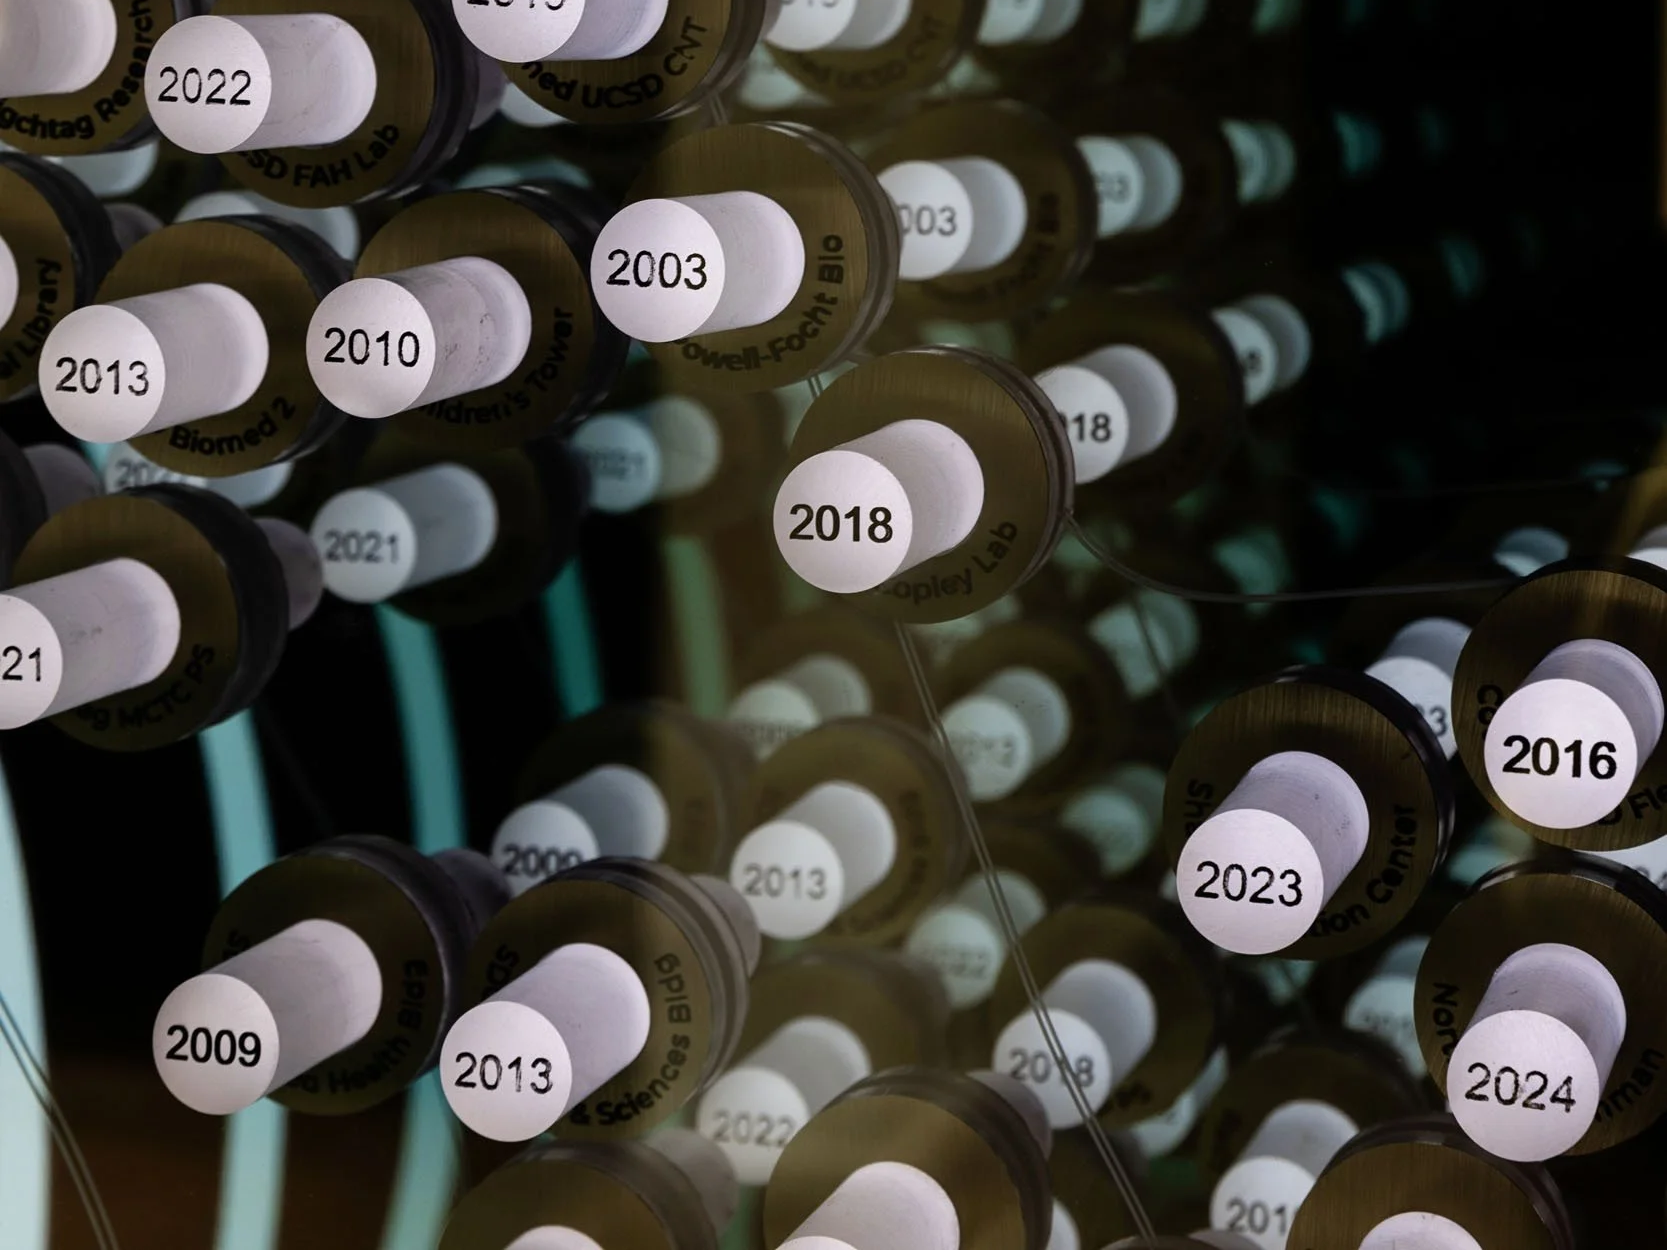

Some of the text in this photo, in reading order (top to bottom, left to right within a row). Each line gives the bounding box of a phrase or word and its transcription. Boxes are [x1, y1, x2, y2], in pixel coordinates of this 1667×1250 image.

[158, 66, 251, 105] 2022
[521, 61, 578, 101] ned
[582, 74, 664, 108] UCSD
[238, 123, 400, 189] SD FAH Lab
[606, 248, 708, 290] 2003
[15, 257, 62, 358] Library
[675, 285, 838, 372] owell-Focht
[818, 234, 845, 285] Bio
[324, 327, 420, 368] 2010
[524, 307, 574, 391] Tower
[55, 357, 149, 396] 2013
[169, 396, 296, 456] Biomed 2
[789, 504, 893, 543] 2018
[324, 530, 399, 564] 2021
[880, 521, 1018, 606] opley Lab
[2, 646, 41, 682] 21
[118, 681, 192, 727] MCTC
[184, 644, 215, 687] PS
[1503, 735, 1617, 780] 2016
[744, 864, 828, 900] 2013
[1195, 861, 1303, 906] 2023
[1310, 805, 1417, 937] tion Center
[166, 1025, 262, 1067] 2009
[327, 959, 430, 1094] Health Bldg
[597, 1034, 691, 1126] Sciences
[654, 953, 692, 1024] Bldg
[455, 1052, 553, 1094] 2013
[1465, 1062, 1576, 1112] 2024
[1226, 1200, 1290, 1235] 201
